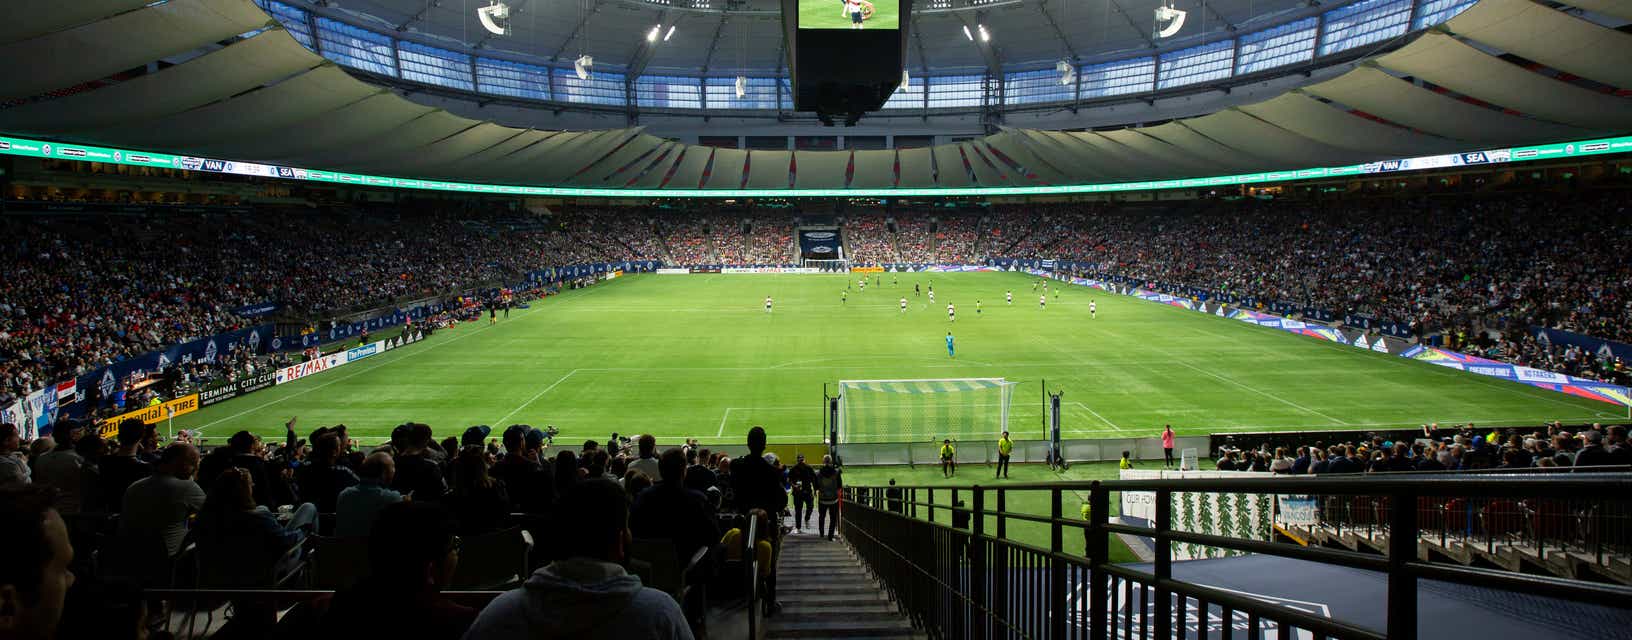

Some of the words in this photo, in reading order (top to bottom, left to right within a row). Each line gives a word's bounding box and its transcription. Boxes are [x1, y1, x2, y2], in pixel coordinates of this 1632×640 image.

[1466, 153, 1484, 163] SEA
[205, 160, 222, 170] VAN
[1383, 161, 1399, 170] VAN
[280, 168, 293, 177] SEA
[287, 357, 328, 380] RE/MAX
[200, 383, 237, 400] TERMINAL
[241, 377, 257, 388] CITY
[258, 372, 276, 383] CLUB
[173, 399, 195, 412] TIRE
